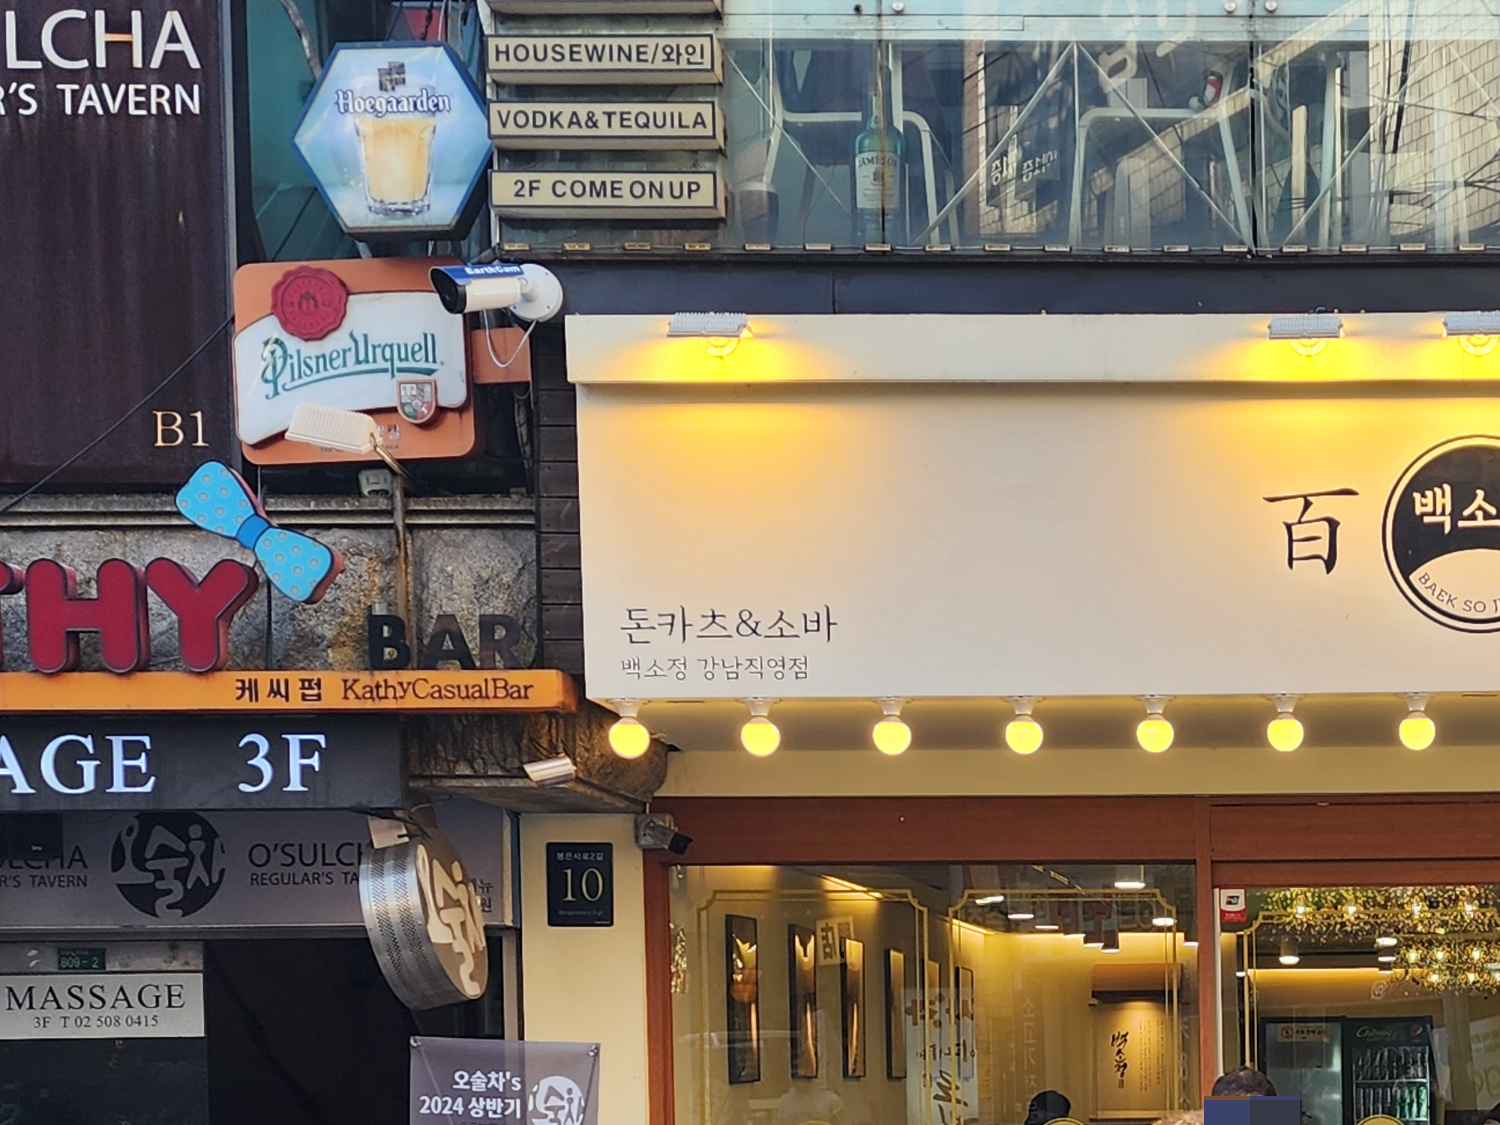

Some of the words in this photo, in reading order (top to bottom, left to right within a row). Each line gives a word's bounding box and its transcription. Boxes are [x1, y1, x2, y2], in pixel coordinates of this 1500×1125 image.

[494, 42, 706, 66] HOUSEWINE/와인
[56, 83, 200, 115] TAVERN
[335, 87, 452, 118] Hoegaarden
[497, 109, 707, 130] VODKA&TEQUILA
[513, 179, 541, 198] 2F
[552, 179, 624, 199] COME
[629, 180, 663, 199] ON
[669, 181, 701, 200] UP
[260, 336, 352, 400] Pilsner
[350, 329, 438, 380] Urquell
[153, 410, 210, 447] B1
[1262, 487, 1360, 575] 百
[1417, 570, 1459, 609] BAEK
[1461, 599, 1488, 614] SO
[620, 604, 838, 644] 돈카츠&소바
[367, 613, 522, 671] BAR
[621, 655, 687, 681] 백소정
[697, 654, 809, 681] 강남직영점
[237, 733, 327, 793] 3F
[29, 874, 87, 888] TAVERN
[250, 870, 334, 887] REGULAR'S
[562, 868, 604, 902] 10
[5, 983, 186, 1011] MASSAGE
[33, 1015, 51, 1029] 3F
[62, 1015, 71, 1029] T
[74, 1015, 92, 1029] 02
[95, 1015, 122, 1029] 508
[125, 1014, 159, 1028] 0415
[452, 1070, 521, 1092] 오술차's
[419, 1096, 464, 1115] 2024
[468, 1097, 521, 1119] 상반기
